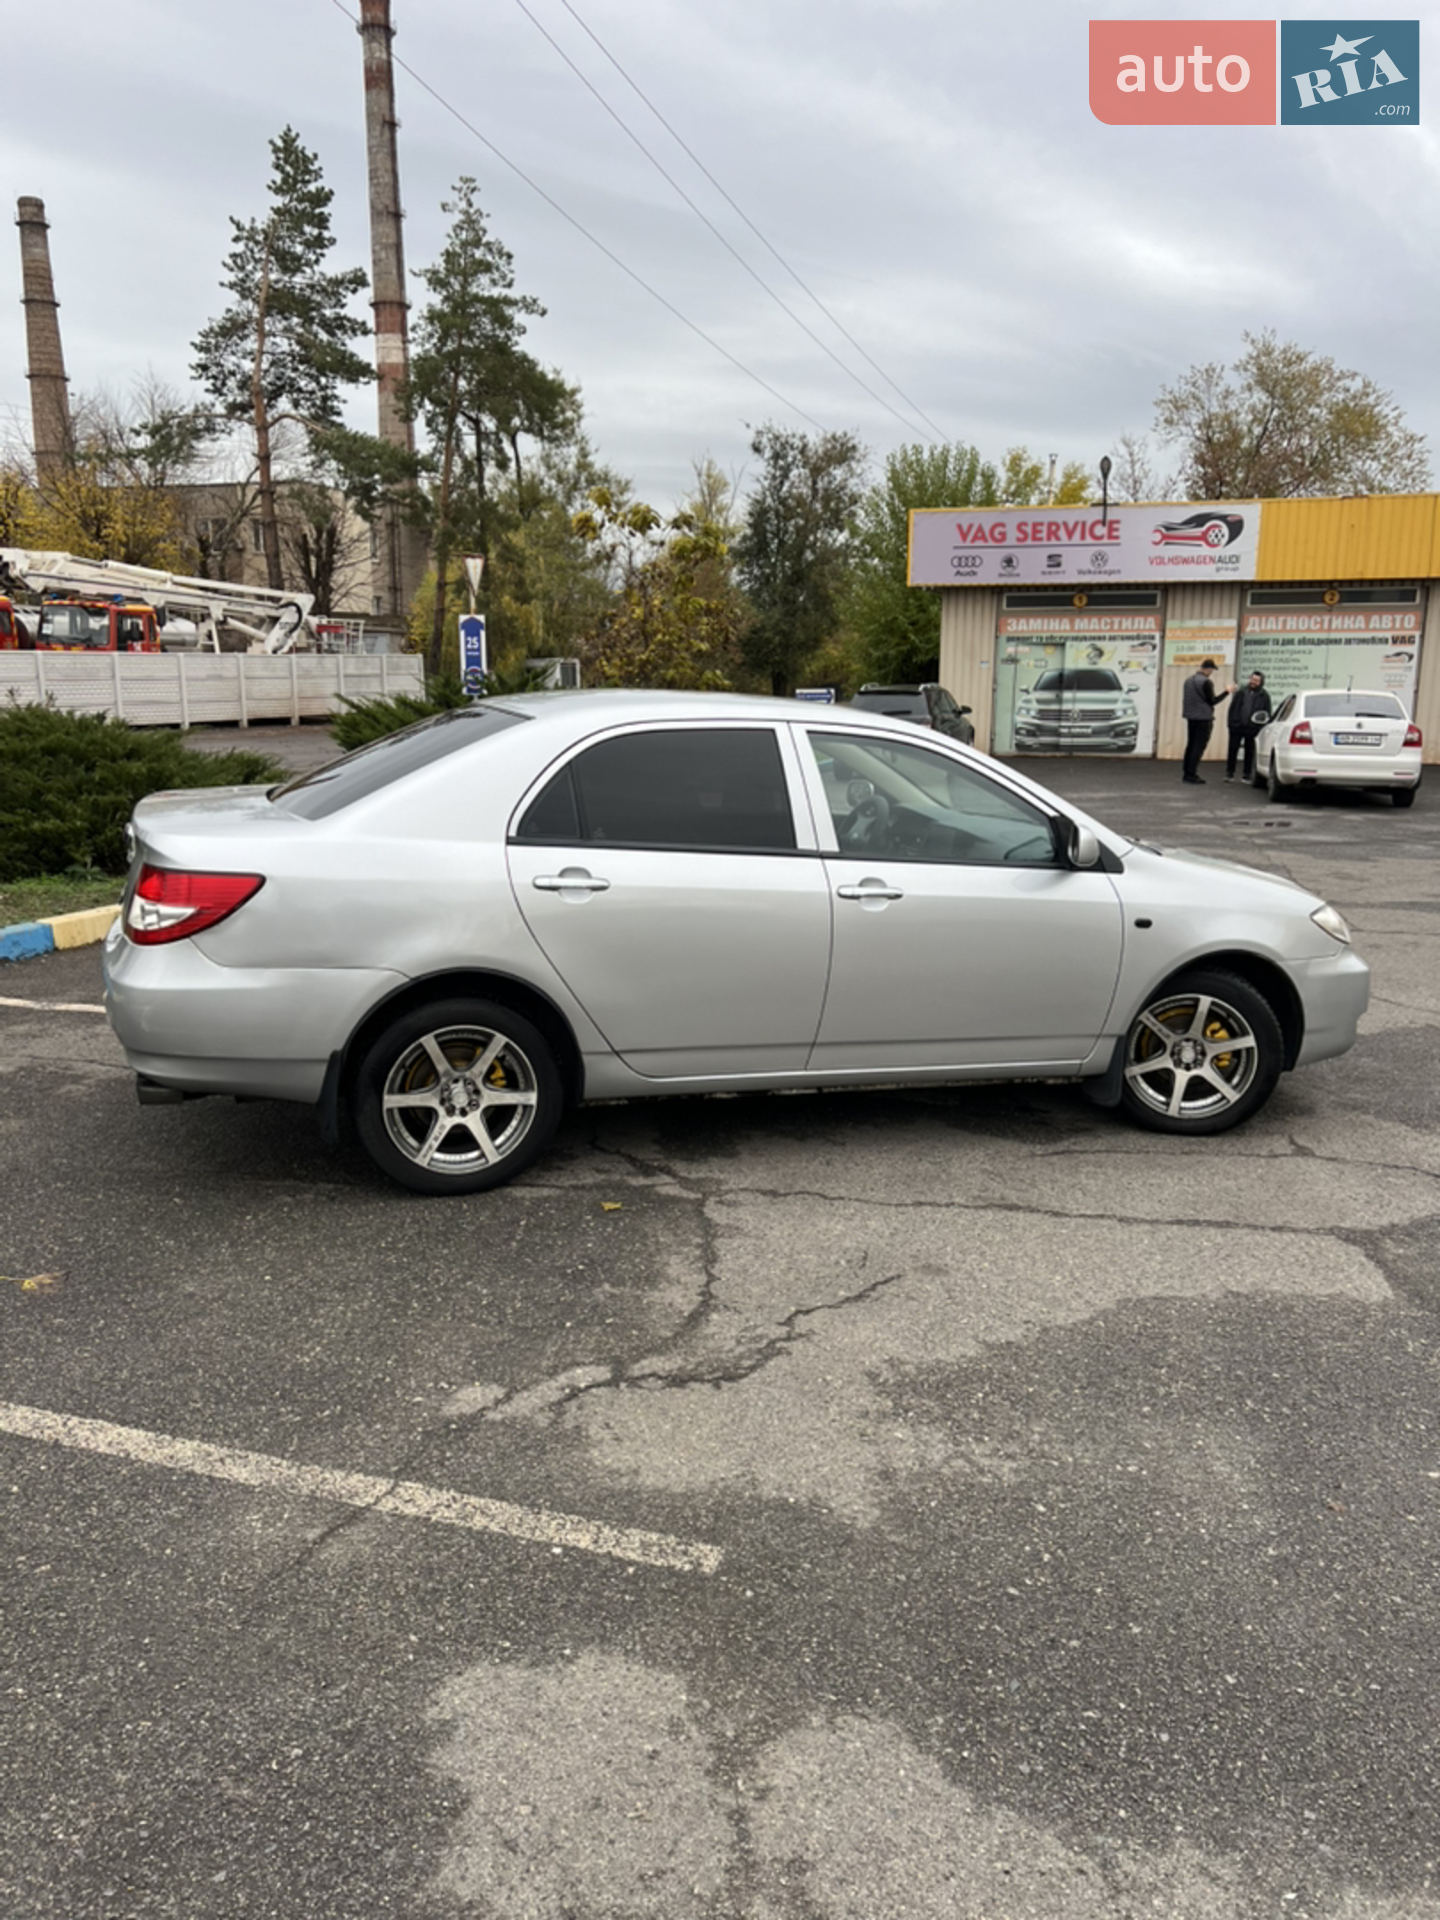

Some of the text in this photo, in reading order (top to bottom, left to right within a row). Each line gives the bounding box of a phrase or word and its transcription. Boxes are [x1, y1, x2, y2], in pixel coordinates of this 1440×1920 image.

[956, 519, 1121, 544] VAG SERVICE
[954, 569, 978, 577] Audi
[1006, 616, 1157, 632] ЗАМІНА МАСТИЛА
[1246, 614, 1416, 632] ДІАГНОСТИКА АВТО
[466, 636, 479, 649] 25
[1391, 635, 1416, 645] VAG
